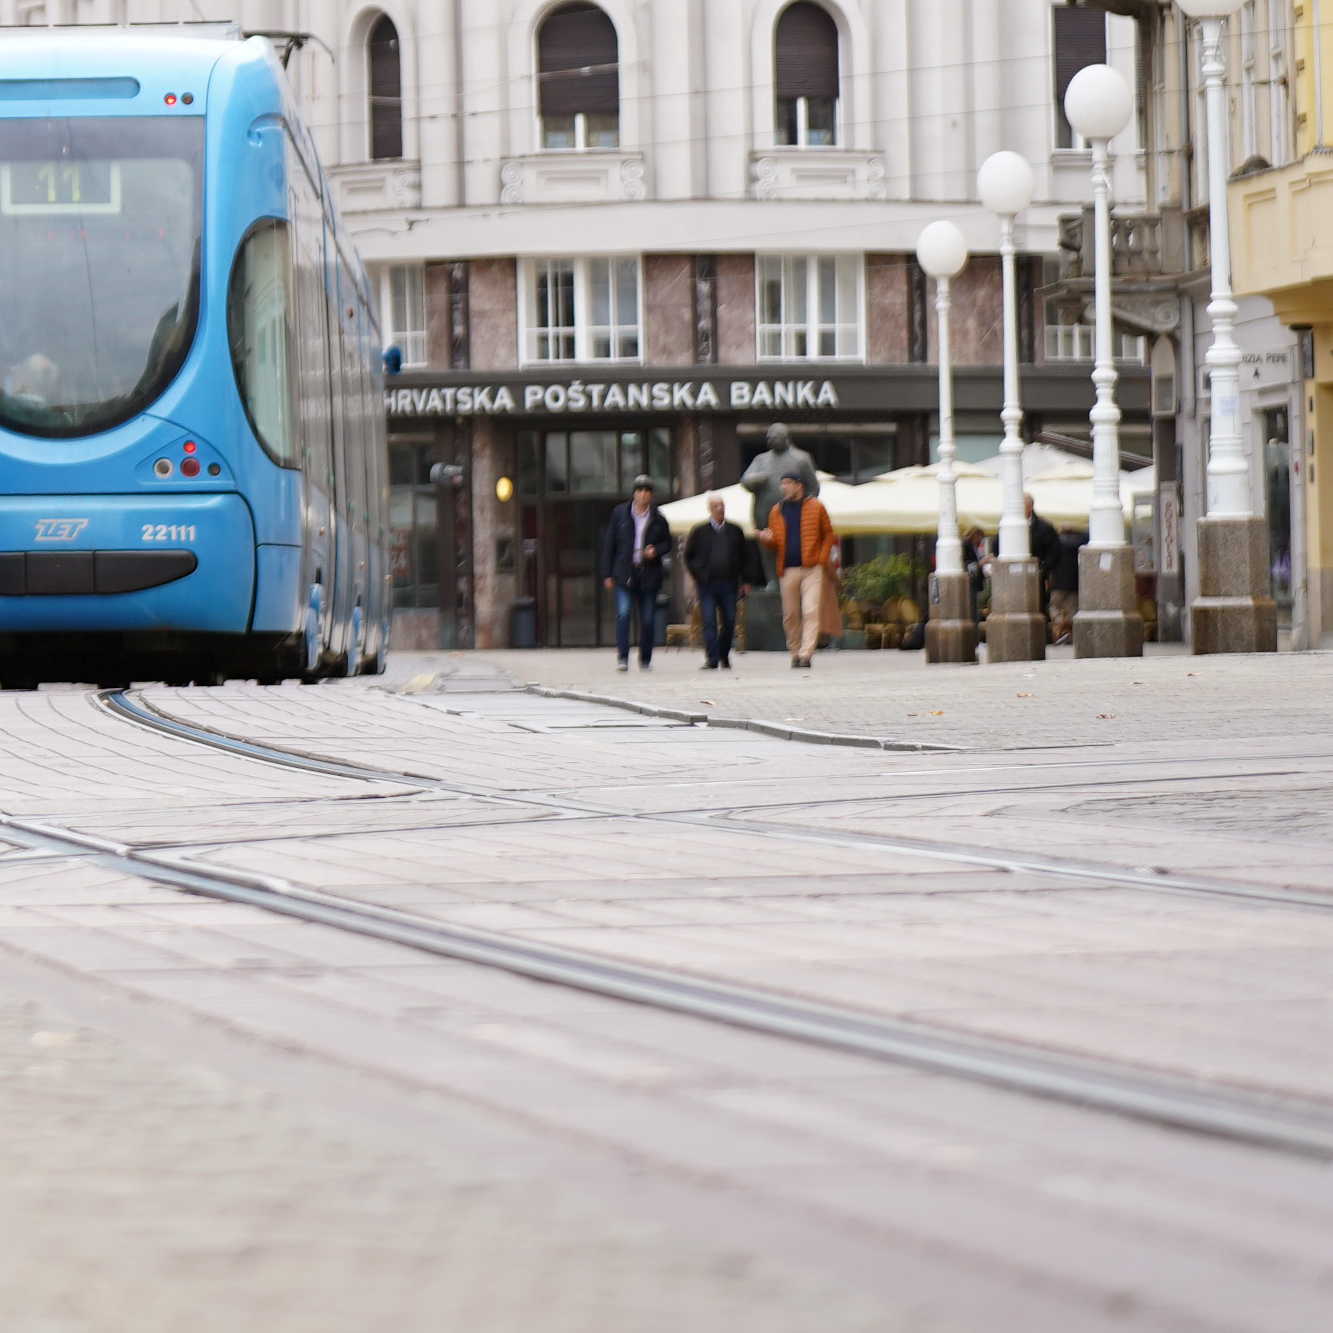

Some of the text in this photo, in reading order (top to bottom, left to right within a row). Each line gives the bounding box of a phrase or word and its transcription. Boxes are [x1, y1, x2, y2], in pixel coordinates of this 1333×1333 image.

[37, 162, 81, 203] 11
[383, 380, 839, 415] HRVATSKA POŠTANSKA BANKA
[34, 518, 89, 541] ZET
[141, 524, 197, 541] 22111
